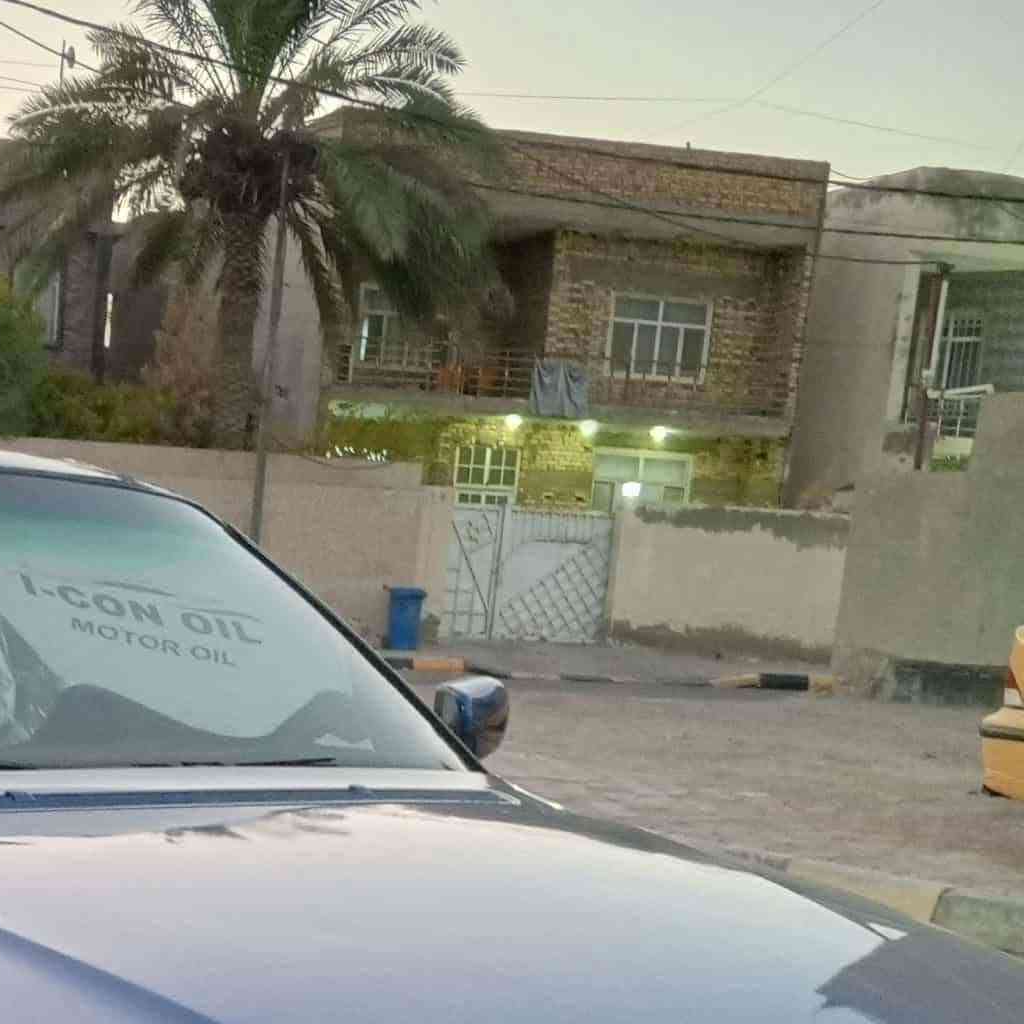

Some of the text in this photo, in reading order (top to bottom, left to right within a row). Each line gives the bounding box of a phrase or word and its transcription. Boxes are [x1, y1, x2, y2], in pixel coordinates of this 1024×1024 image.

[70, 617, 238, 668] MOTOR OIL
[180, 611, 262, 645] OIL
